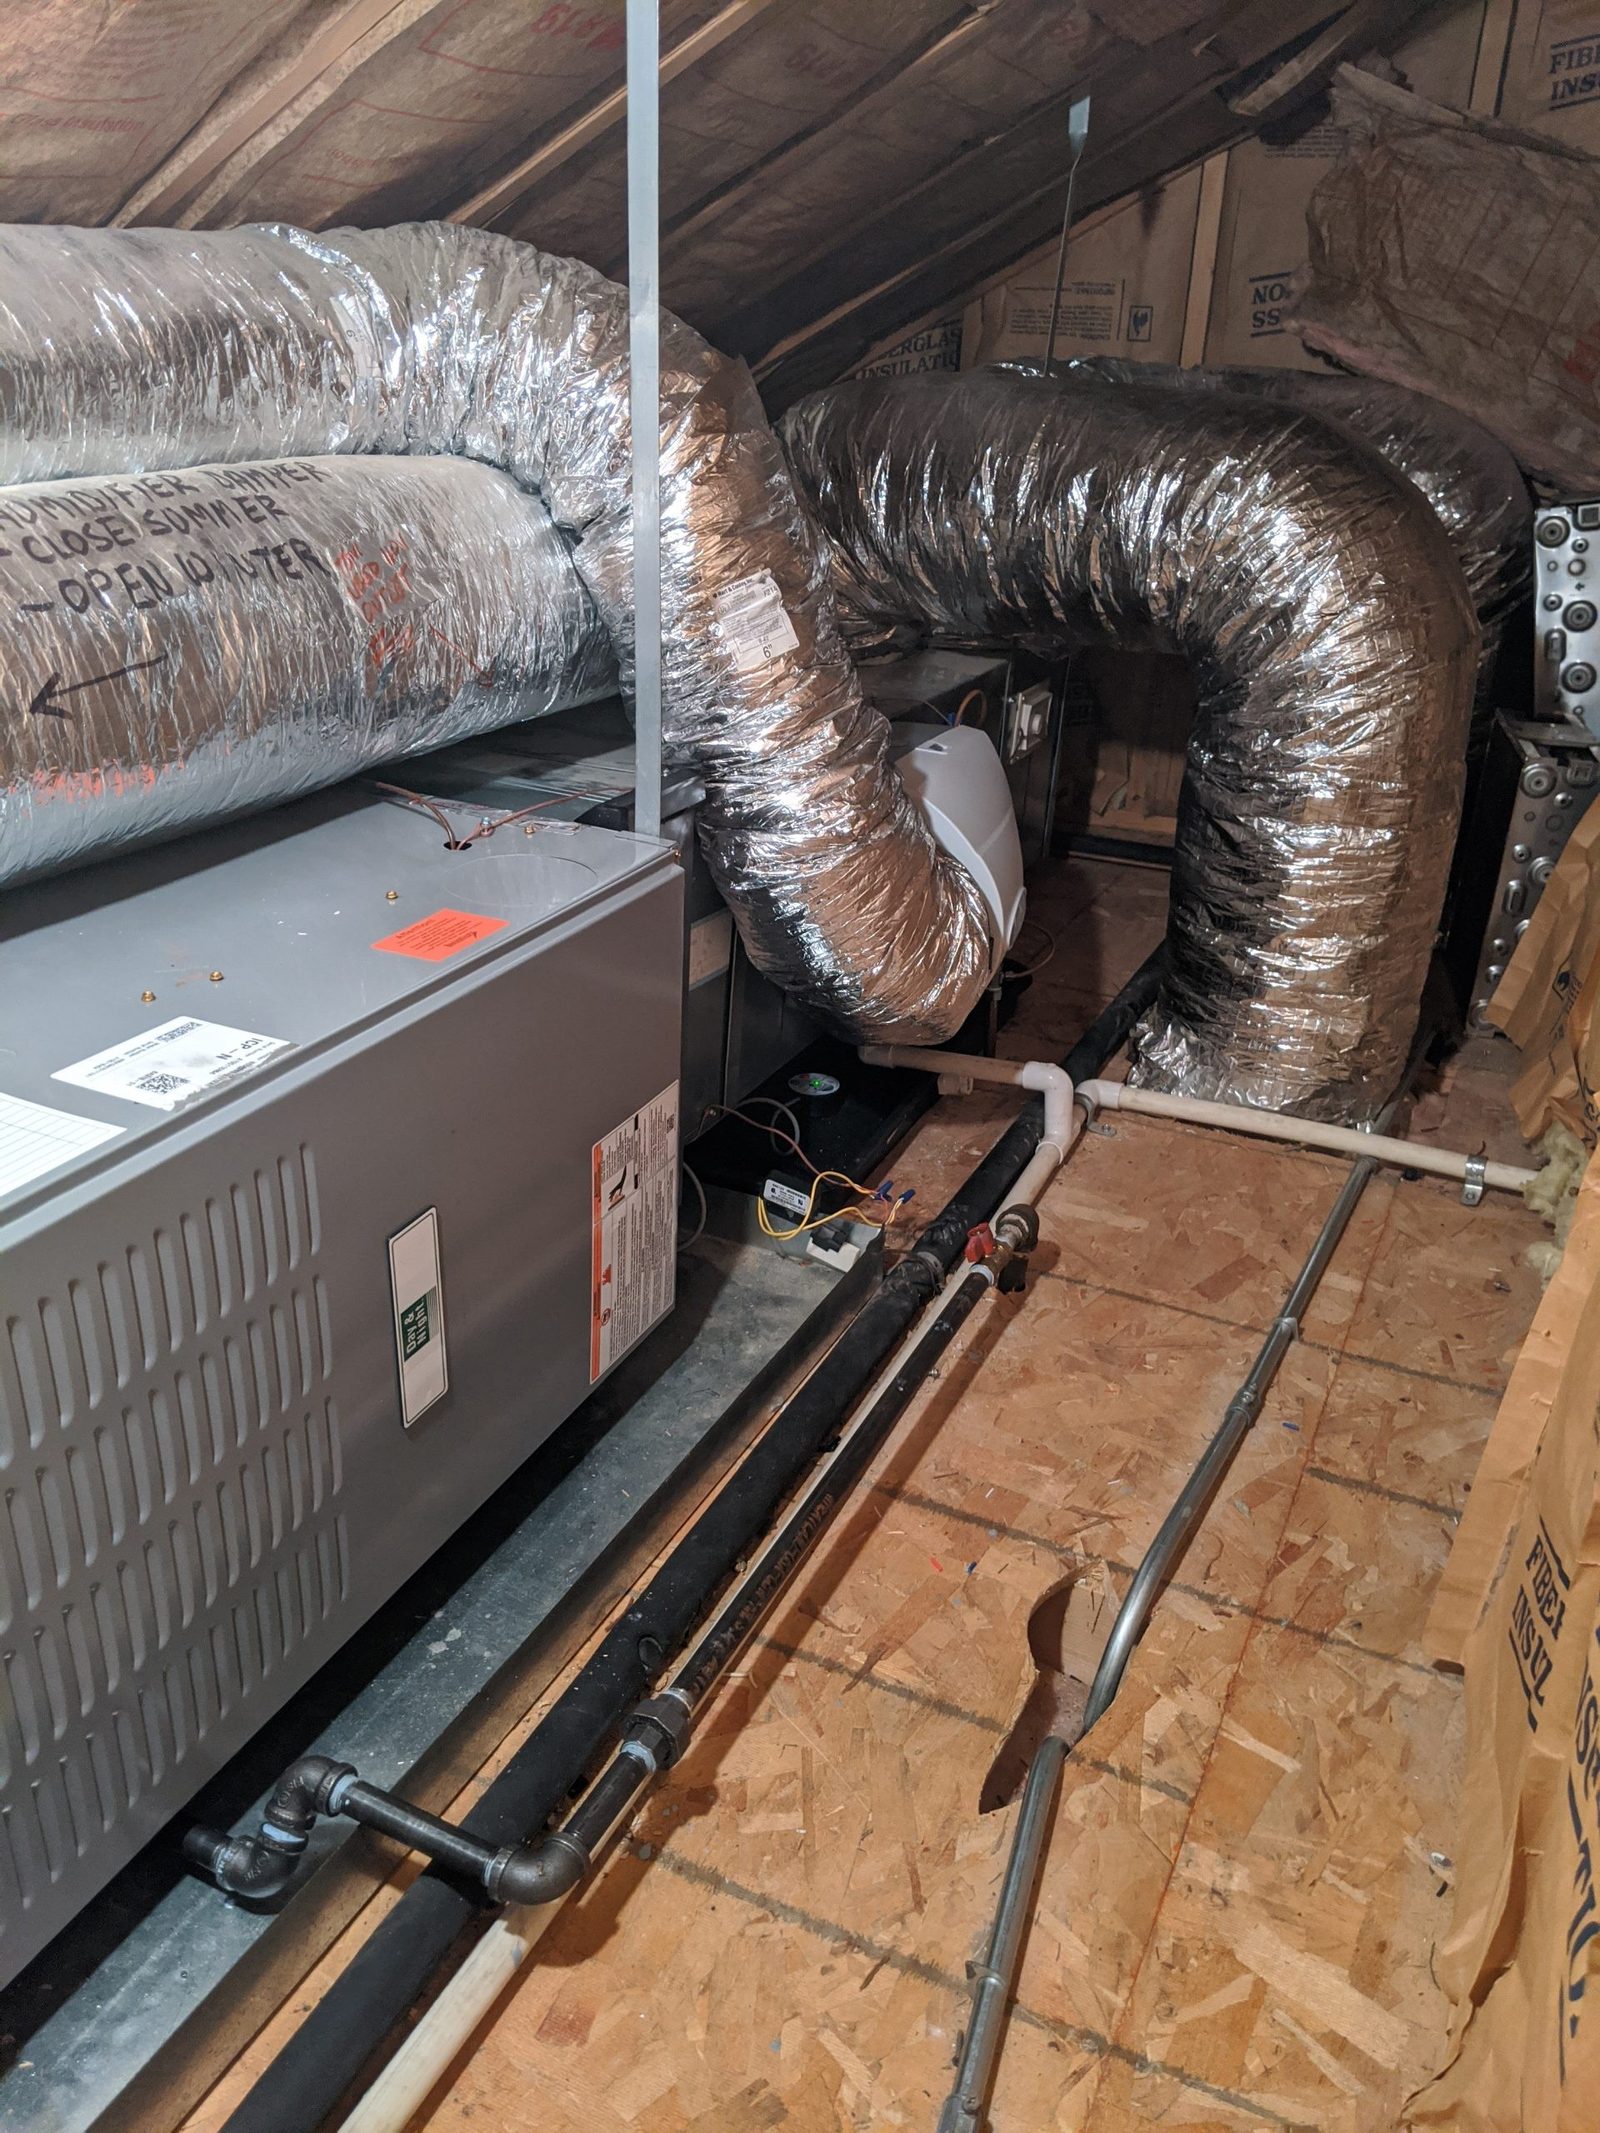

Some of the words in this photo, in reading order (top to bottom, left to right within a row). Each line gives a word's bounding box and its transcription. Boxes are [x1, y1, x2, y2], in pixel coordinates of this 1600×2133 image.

[199, 461, 333, 493] DAMPER
[144, 494, 289, 536] SUMMER
[175, 538, 331, 586] WINTER
[404, 1311, 415, 1326] &
[415, 1301, 427, 1346] Night
[406, 1327, 416, 1354] Day
